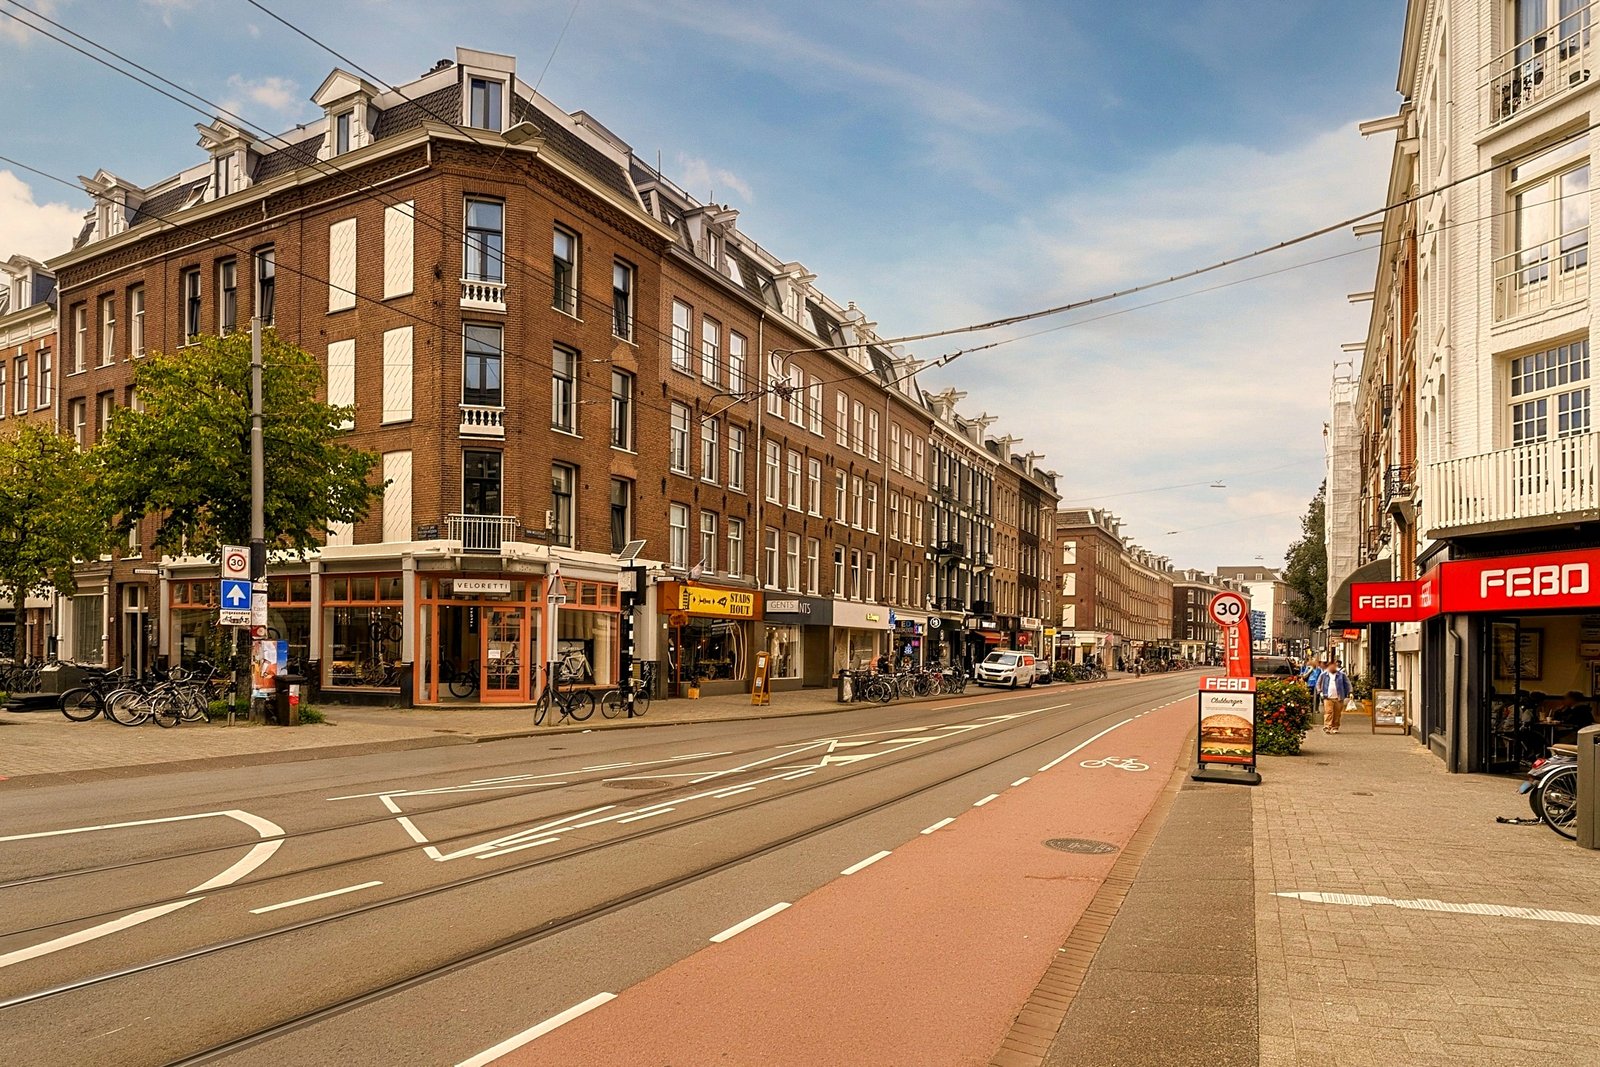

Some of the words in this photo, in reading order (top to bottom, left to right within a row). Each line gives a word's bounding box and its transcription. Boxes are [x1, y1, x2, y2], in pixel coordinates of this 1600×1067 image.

[230, 558, 243, 567] 30
[1480, 562, 1589, 599] FEBO
[729, 592, 751, 604] STADS
[1358, 594, 1412, 609] FEBO
[729, 604, 751, 615] HOUT
[770, 600, 794, 609] GENTS
[799, 602, 811, 614] NTS
[1216, 602, 1240, 616] 30
[1206, 677, 1250, 691] FEBO
